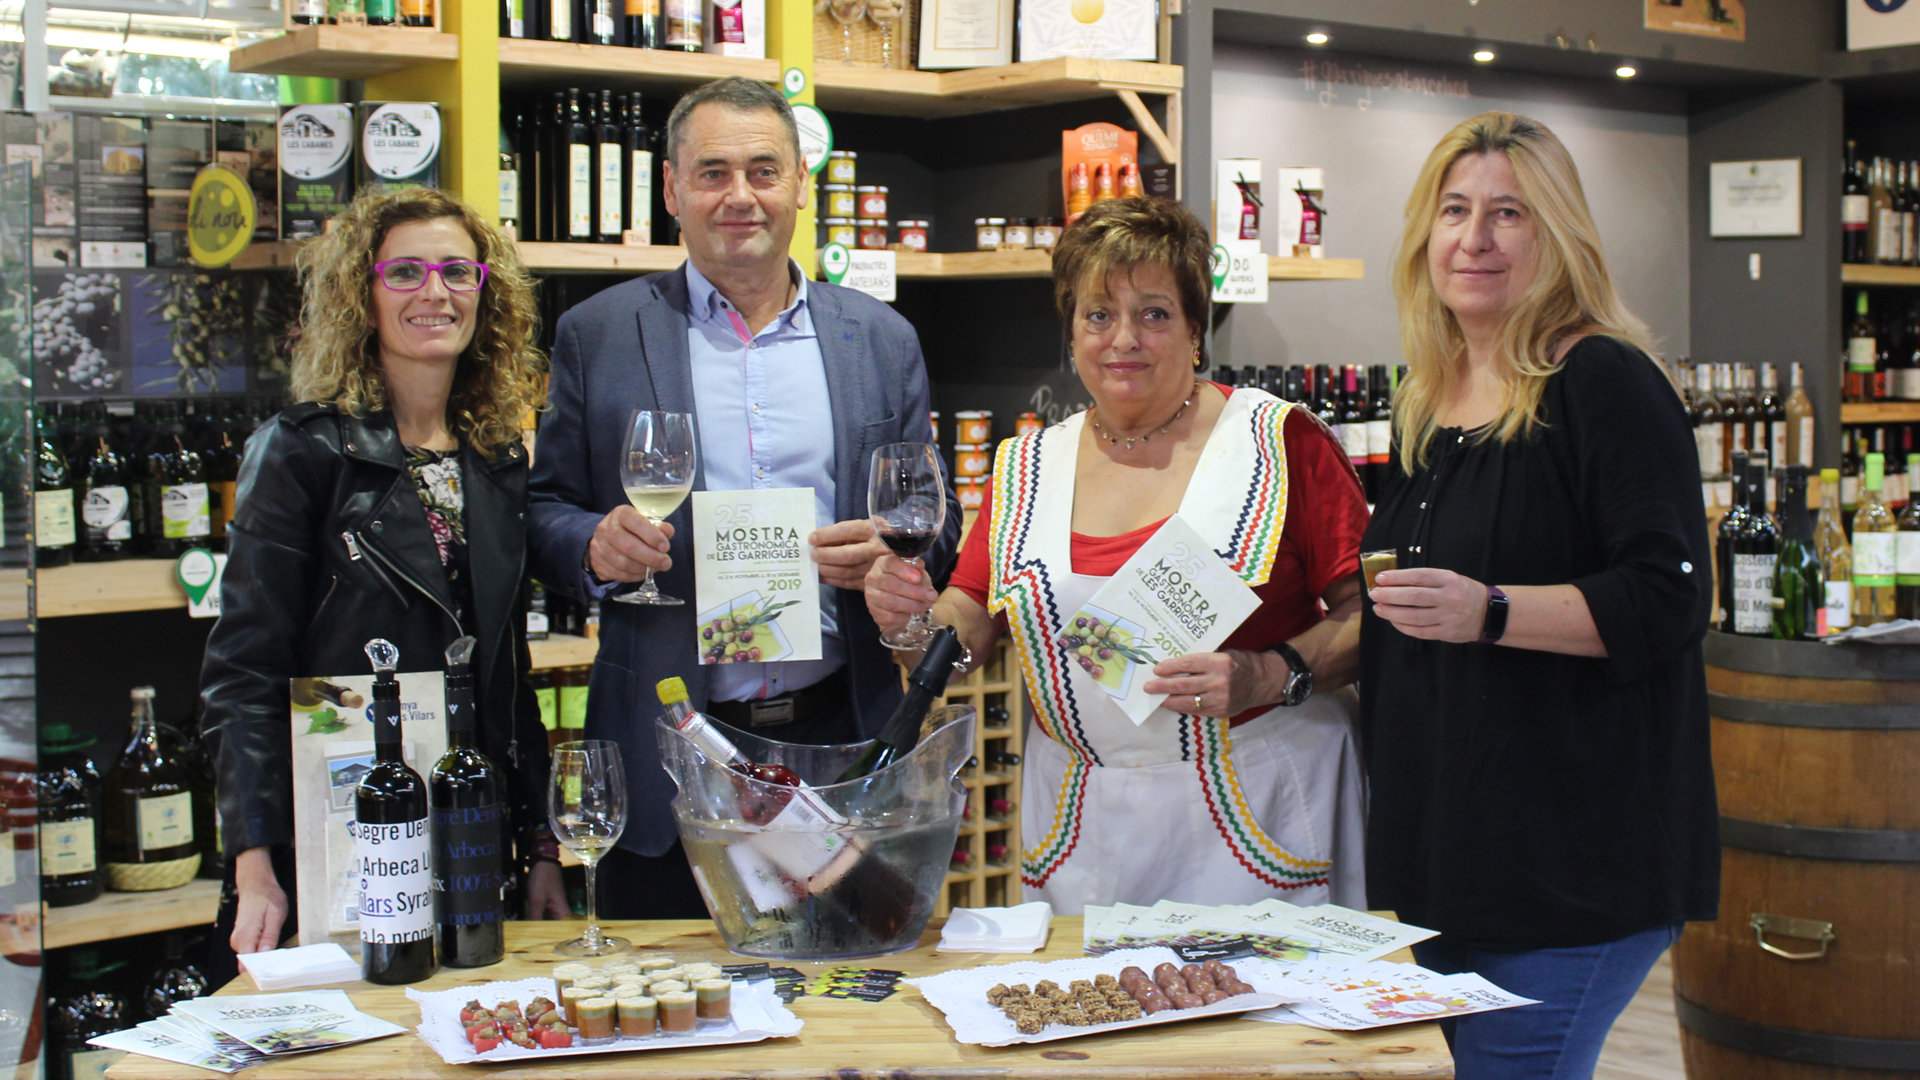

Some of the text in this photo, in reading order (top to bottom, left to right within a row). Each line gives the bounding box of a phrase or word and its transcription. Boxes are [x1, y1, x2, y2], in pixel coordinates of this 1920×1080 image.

[286, 140, 333, 149] LES CABANES
[373, 138, 420, 148] LES CABANES
[713, 503, 755, 529] 25
[715, 527, 799, 542] MOSTRA
[716, 551, 735, 561] LES
[738, 549, 800, 560] GARRIGUES
[1163, 541, 1207, 580] 25
[767, 578, 802, 591] 2019
[1154, 556, 1218, 627] MOSTRA
[1135, 567, 1145, 577] DE
[1141, 573, 1158, 591] LES
[1157, 590, 1205, 639] GARRIGUES
[409, 710, 435, 721] Vilars
[444, 840, 496, 859] Arbeca
[362, 855, 419, 877] Arbeca
[1311, 916, 1396, 941] MOSTRA
